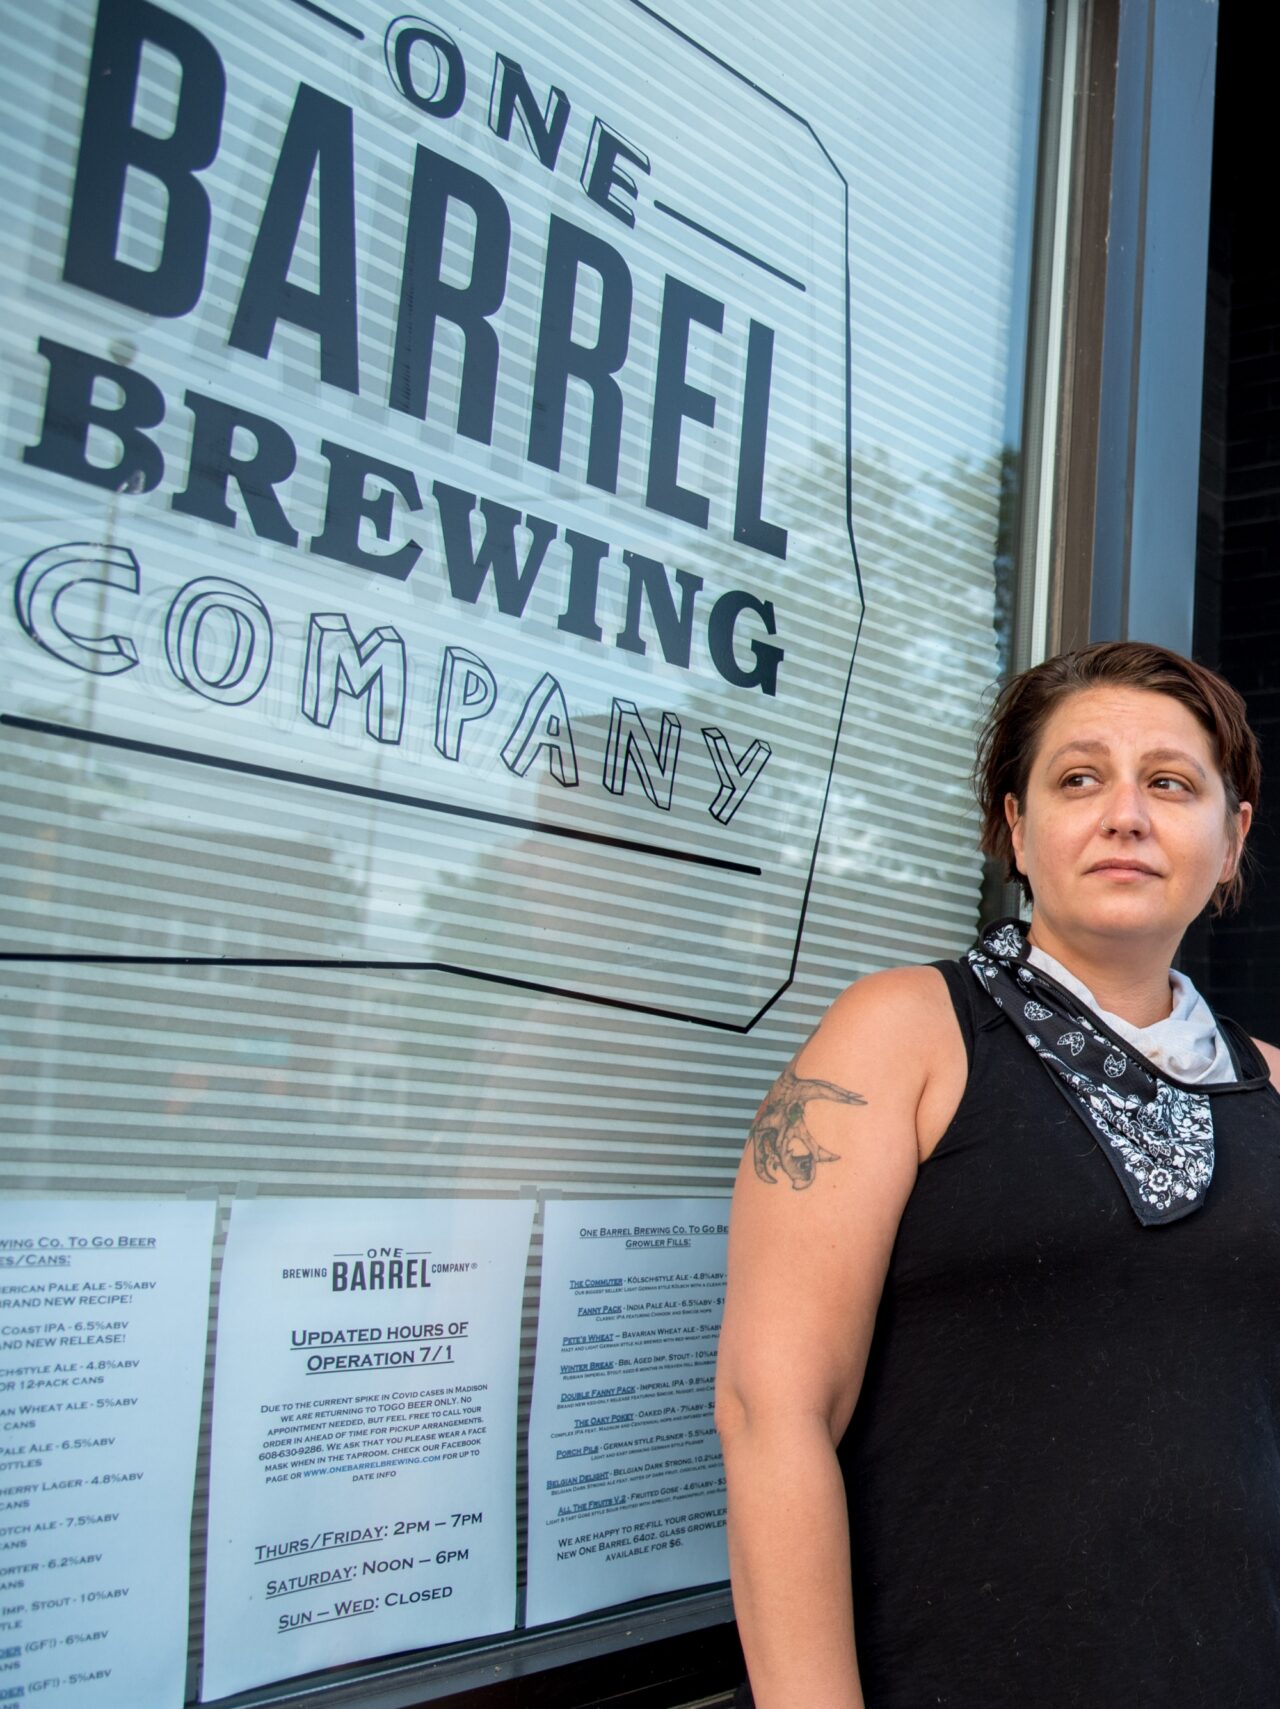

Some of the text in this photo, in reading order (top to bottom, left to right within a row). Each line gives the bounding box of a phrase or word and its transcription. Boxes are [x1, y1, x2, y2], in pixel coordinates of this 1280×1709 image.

[384, 15, 651, 229] ONE
[62, 0, 788, 560] BARREL
[22, 336, 784, 696] BREWING
[14, 542, 772, 824] COMPANY
[367, 1248, 404, 1259] ONE
[282, 1267, 327, 1279] BREWING
[332, 1259, 431, 1292] BARREL
[292, 1322, 468, 1346] UPDATED HOURS OF
[307, 1345, 452, 1371] OPERATION 7/1
[394, 1520, 430, 1538] 2PM
[453, 1512, 483, 1529] 7PM
[436, 1548, 469, 1565] 6PM
